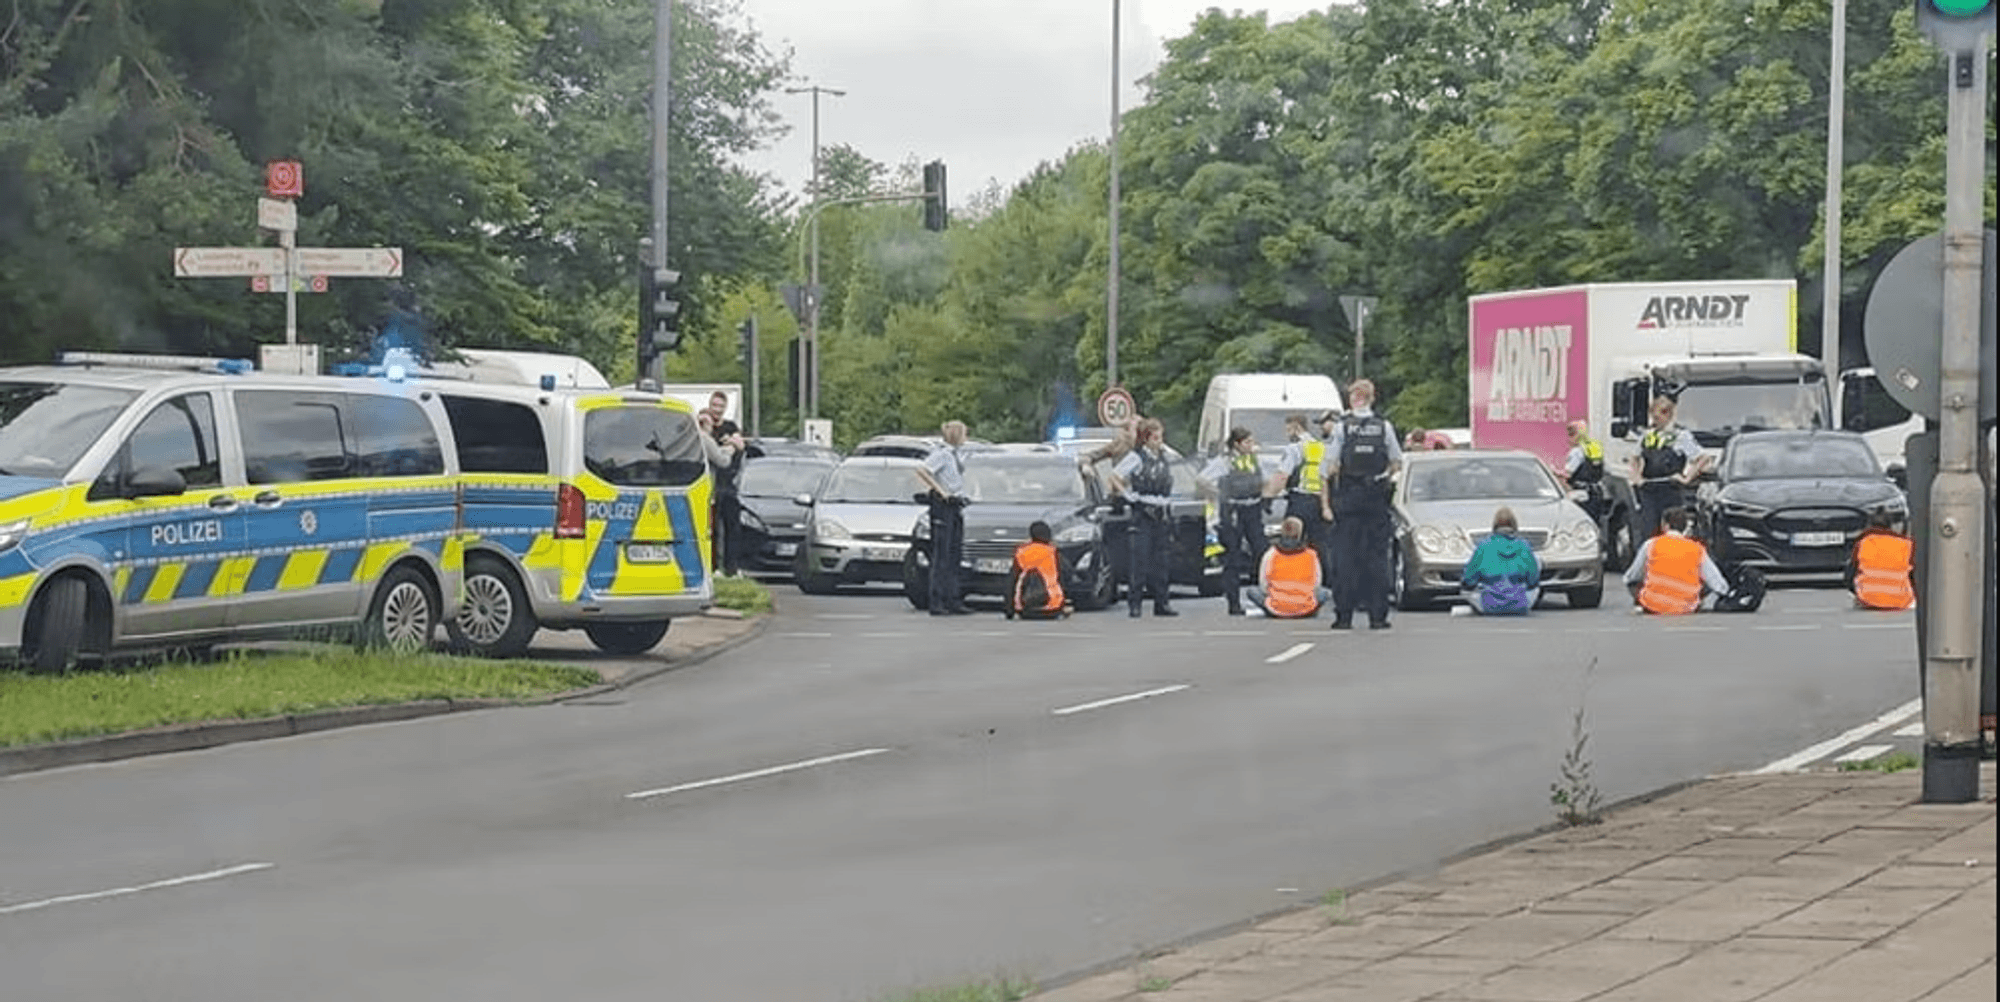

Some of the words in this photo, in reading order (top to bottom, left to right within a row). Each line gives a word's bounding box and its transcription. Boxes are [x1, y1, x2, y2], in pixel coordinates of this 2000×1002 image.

[1637, 295, 1750, 328] ARNDT
[1489, 325, 1572, 420] ARNDT
[1107, 400, 1127, 420] 50
[586, 502, 639, 520] POLIZEI
[151, 520, 223, 546] POLIZEI
